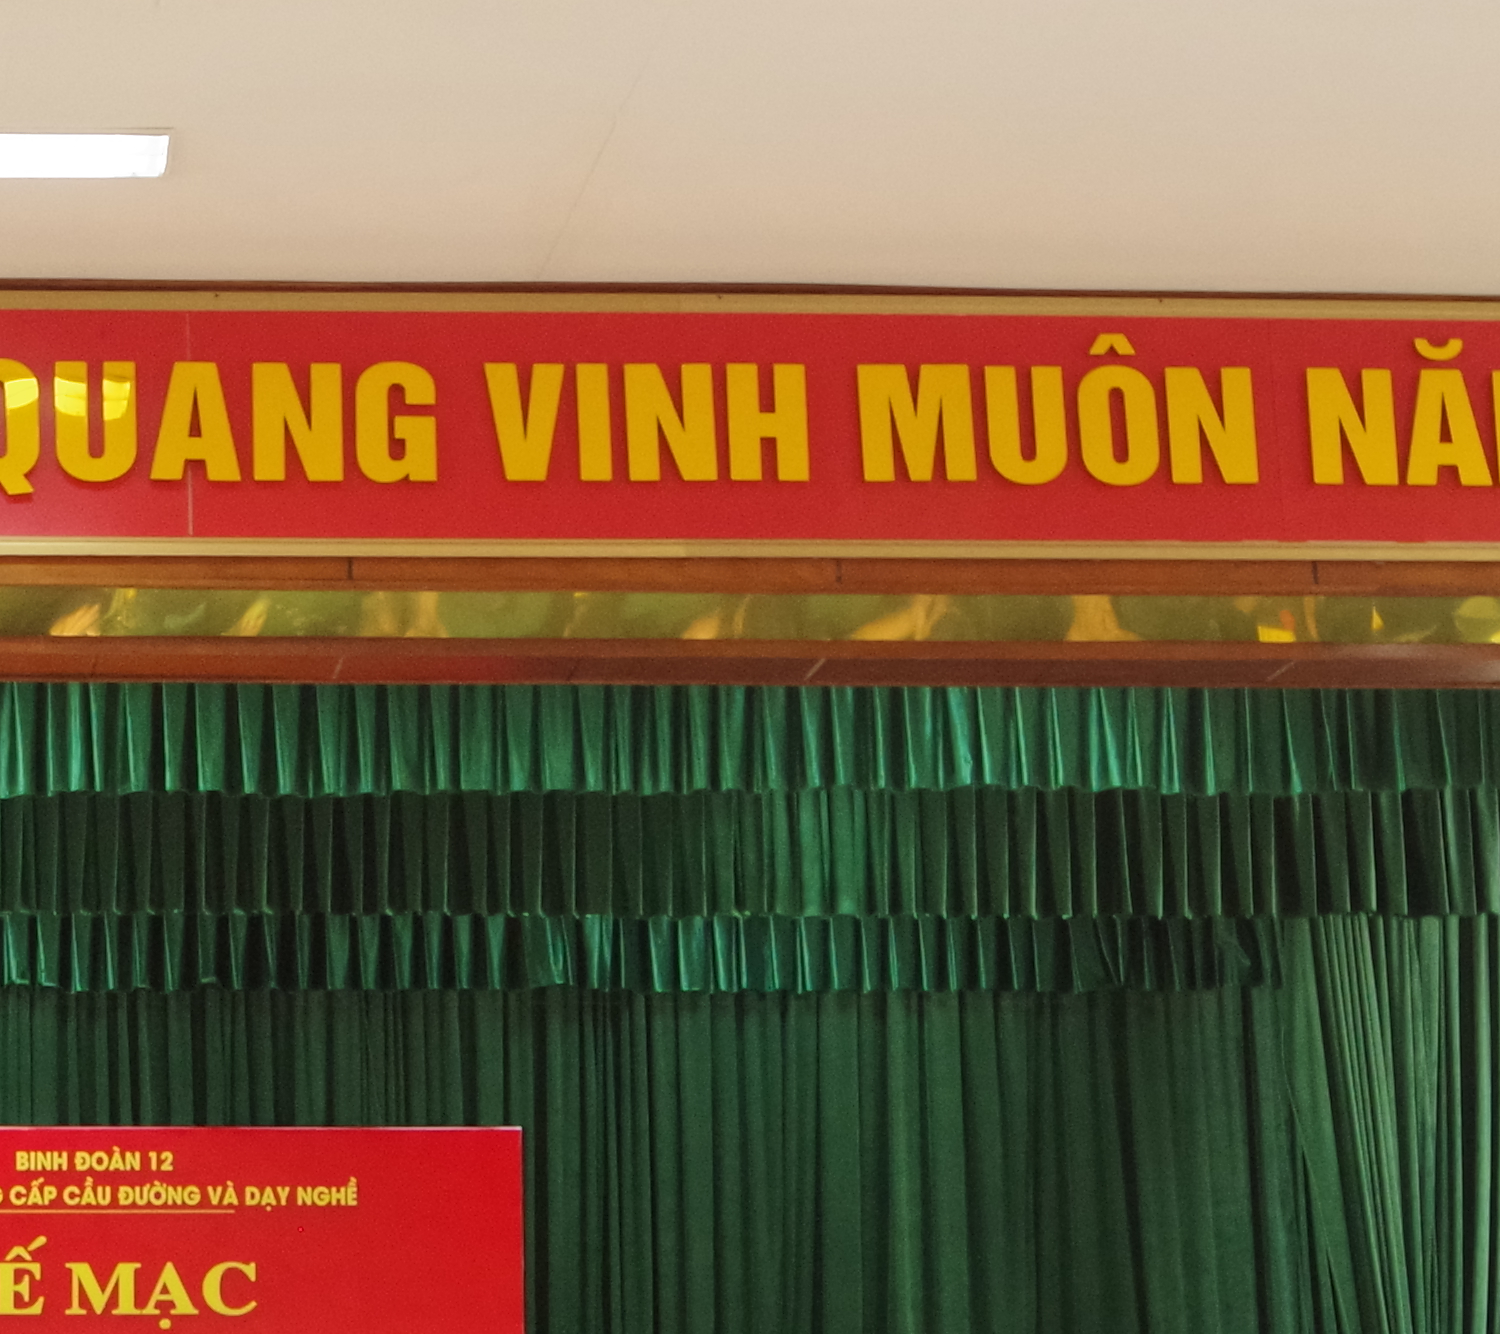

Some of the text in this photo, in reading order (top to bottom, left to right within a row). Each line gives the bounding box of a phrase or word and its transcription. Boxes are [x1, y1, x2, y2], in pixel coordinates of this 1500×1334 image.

[485, 364, 808, 480] VINH
[858, 334, 1258, 485] MUÔN
[16, 1147, 173, 1171] BINH ĐOÀN 12
[10, 1178, 57, 1205] CẤP
[63, 1177, 111, 1205] CẦU
[118, 1181, 201, 1205] ĐƯỜNG
[208, 1182, 238, 1205] VÀ
[245, 1187, 289, 1210] DẠY
[297, 1178, 357, 1206] NGHỀ
[66, 1262, 256, 1329] MẠC
